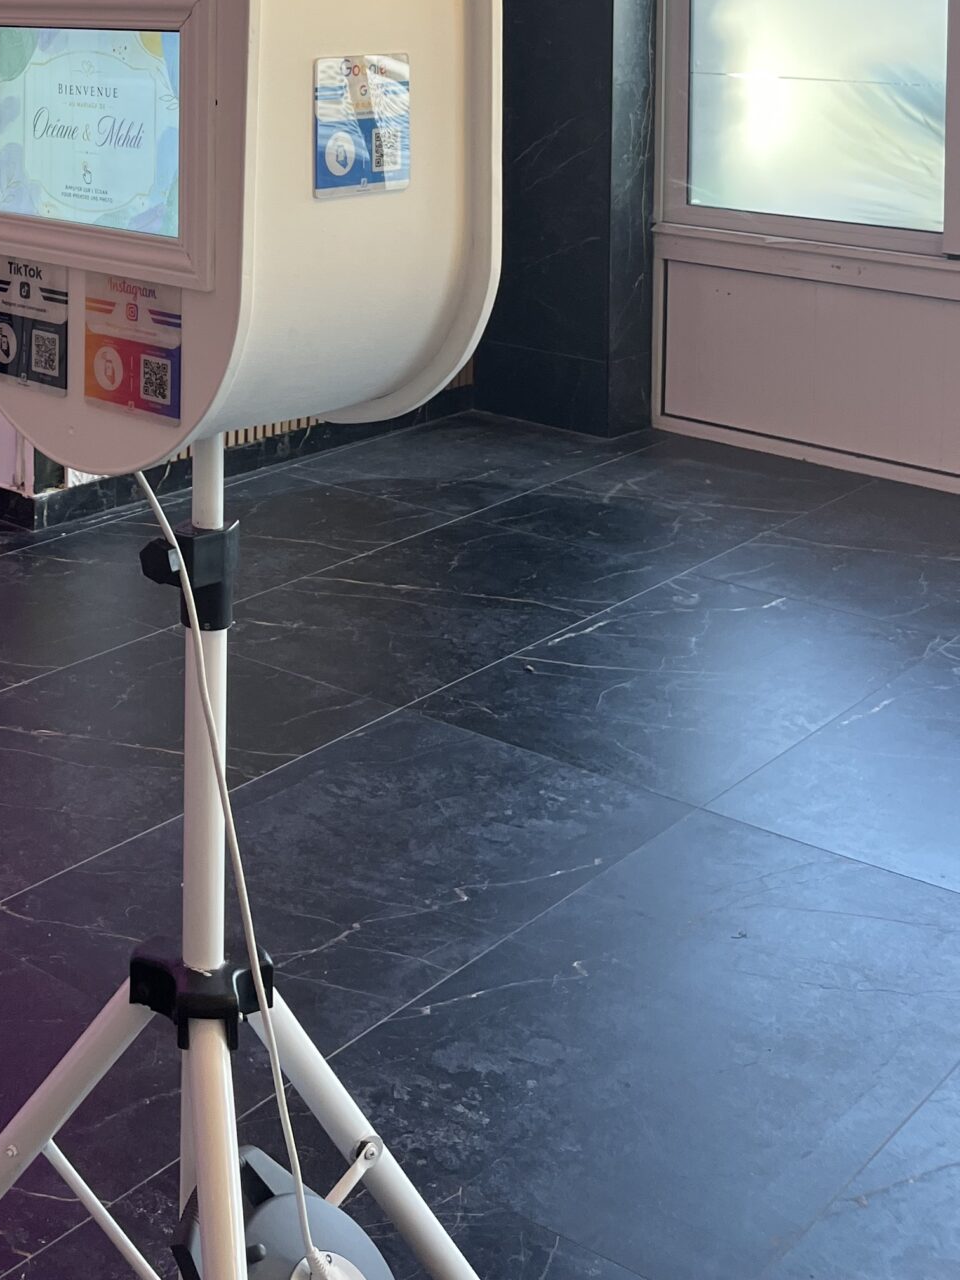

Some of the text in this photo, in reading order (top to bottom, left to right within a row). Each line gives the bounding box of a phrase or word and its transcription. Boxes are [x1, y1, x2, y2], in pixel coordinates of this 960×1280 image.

[58, 83, 120, 99] BIENVENUE
[33, 107, 145, 149] Océane & Mehdi
[7, 261, 43, 280] TikTok
[107, 277, 157, 300] Instagram
